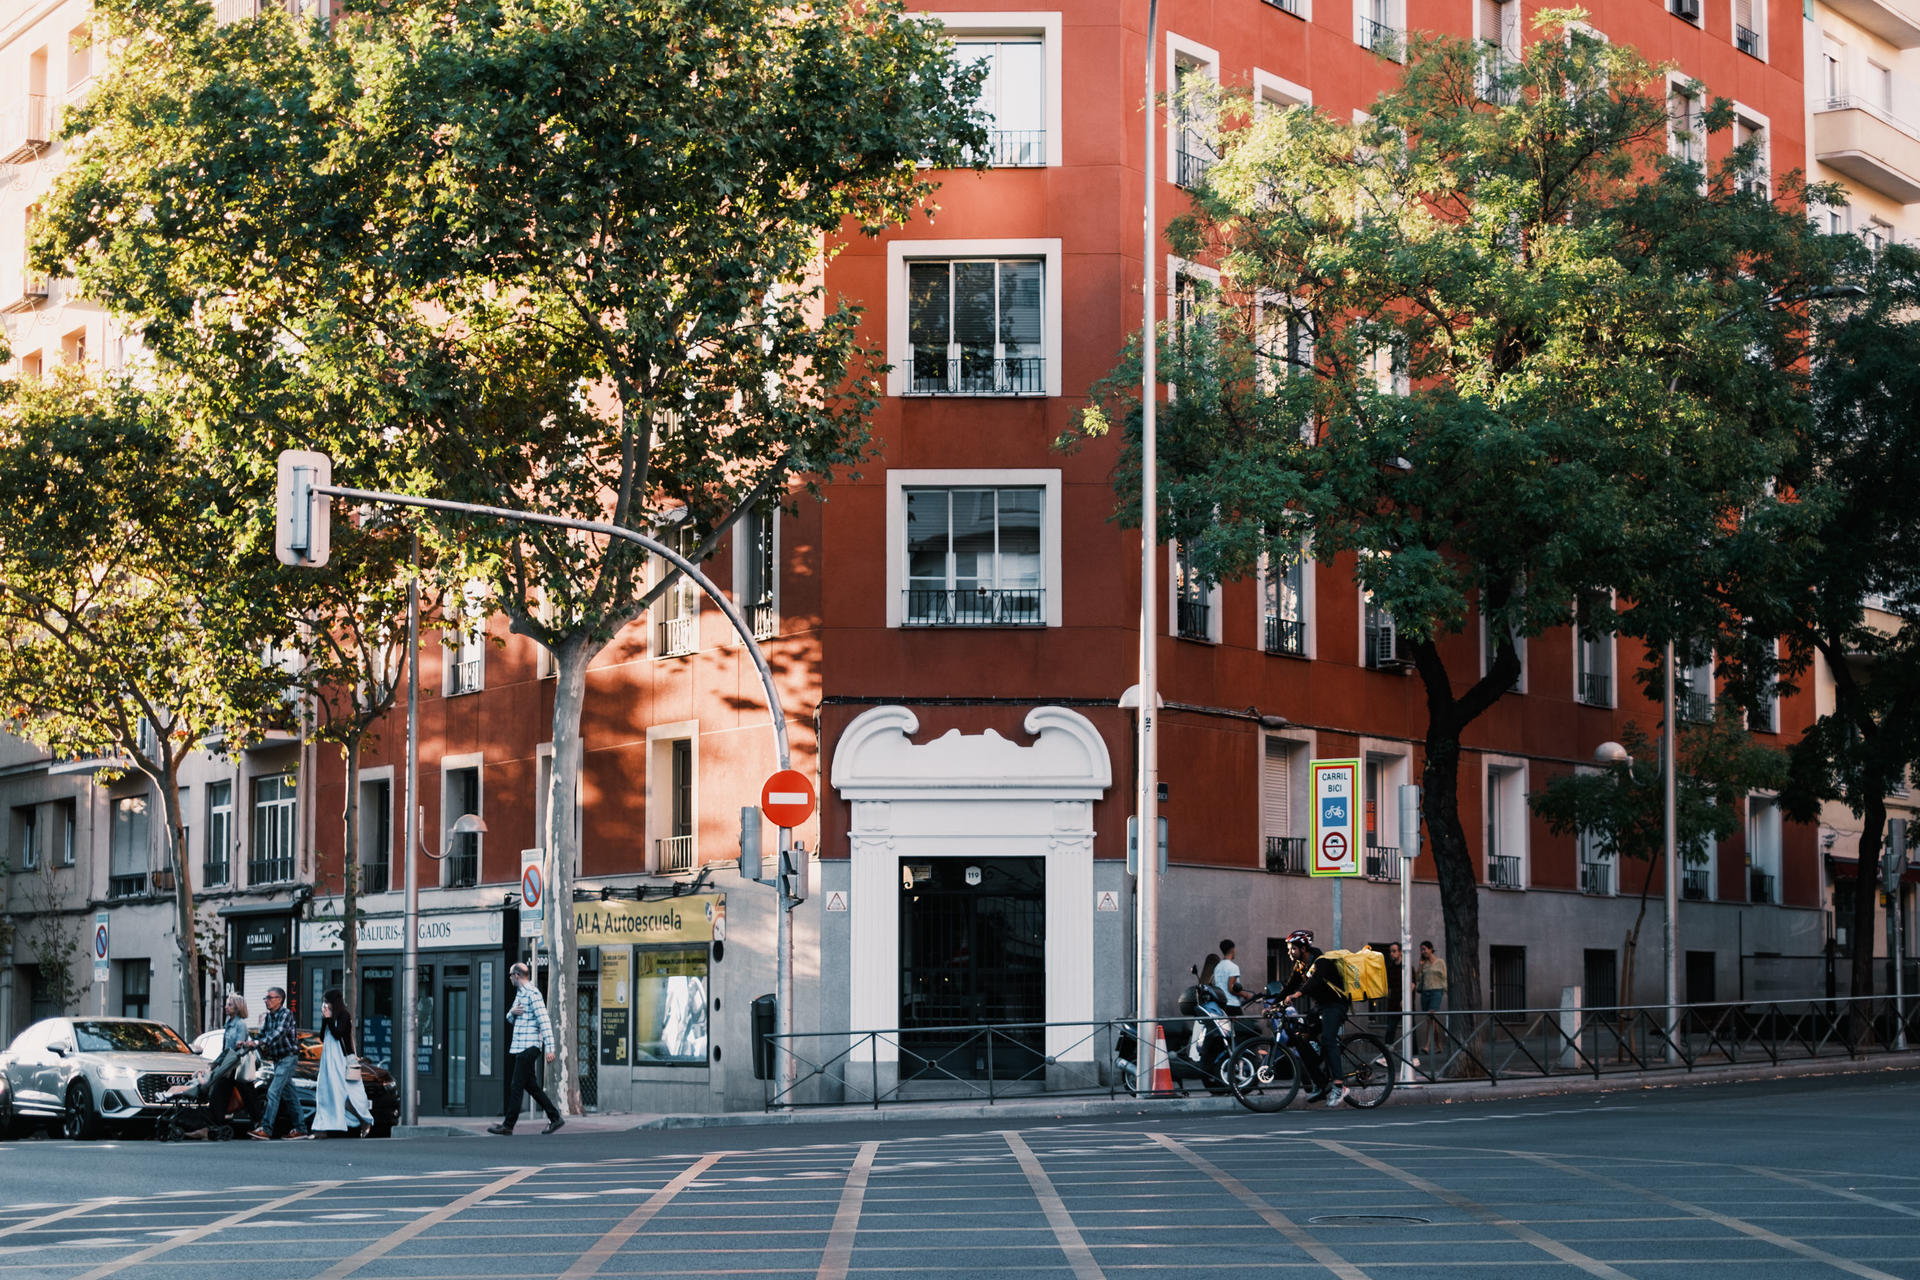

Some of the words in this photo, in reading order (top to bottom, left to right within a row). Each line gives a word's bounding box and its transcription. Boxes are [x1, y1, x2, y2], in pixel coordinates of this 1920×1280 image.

[1322, 772, 1348, 781] CARRIL
[1328, 784, 1342, 793] BICI
[604, 907, 682, 934] Autoescuela
[246, 933, 273, 945] KOMAINU
